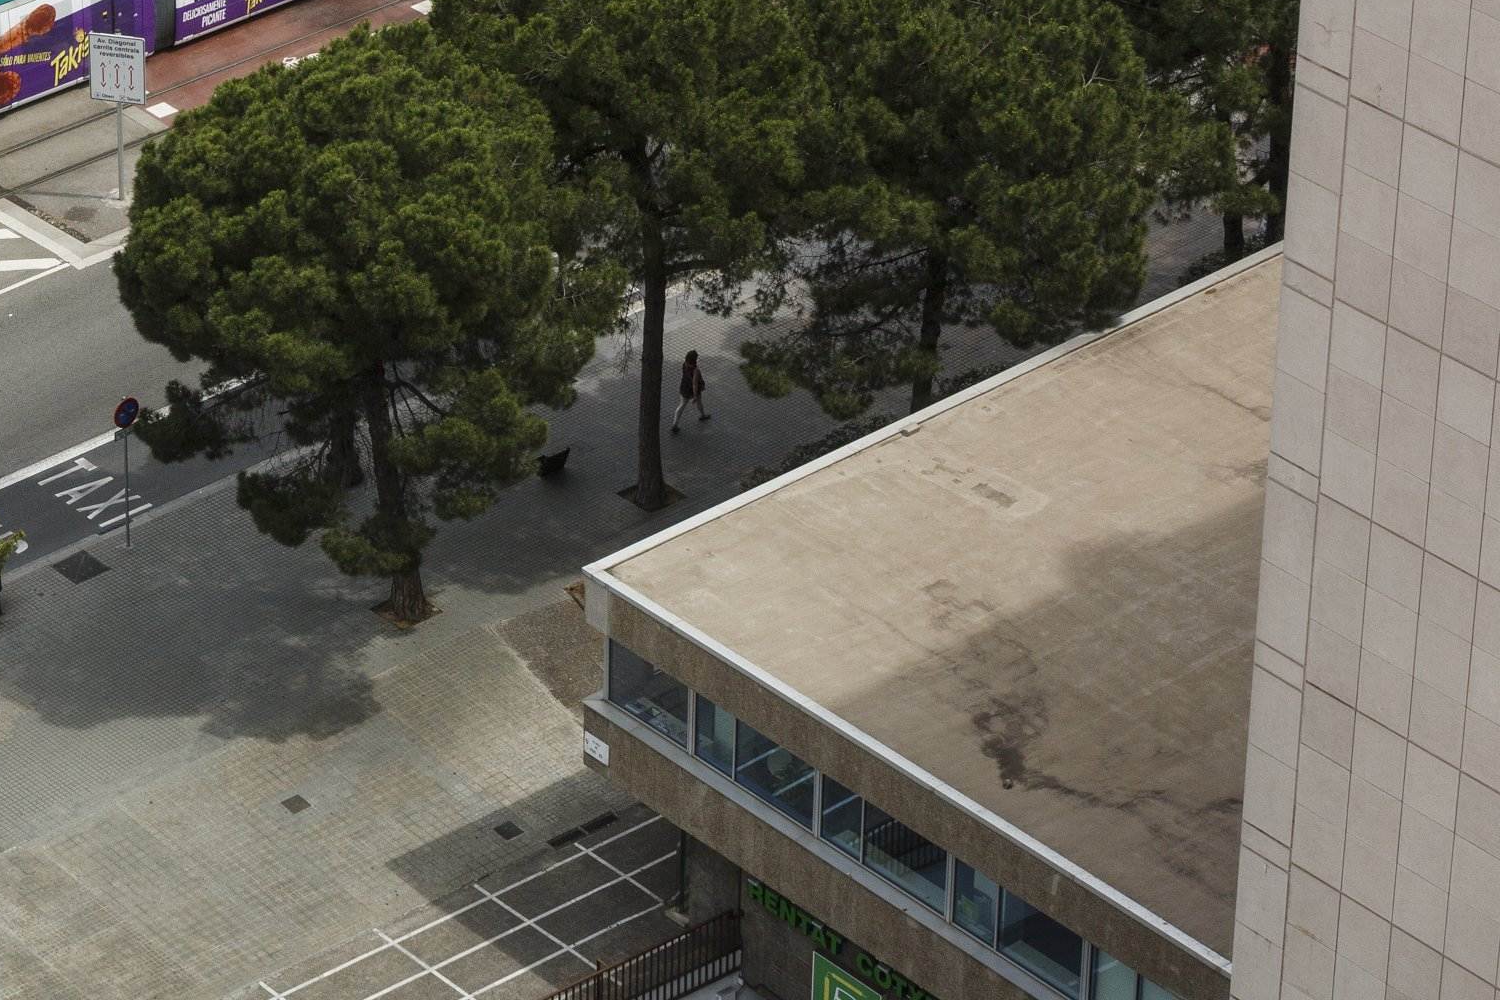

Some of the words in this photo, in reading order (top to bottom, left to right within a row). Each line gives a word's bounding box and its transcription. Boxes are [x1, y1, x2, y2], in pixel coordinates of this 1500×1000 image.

[201, 8, 227, 28] PICANTE
[108, 38, 137, 47] Diagonal
[37, 457, 153, 528] TAXI
[747, 878, 843, 956] RENTAT
